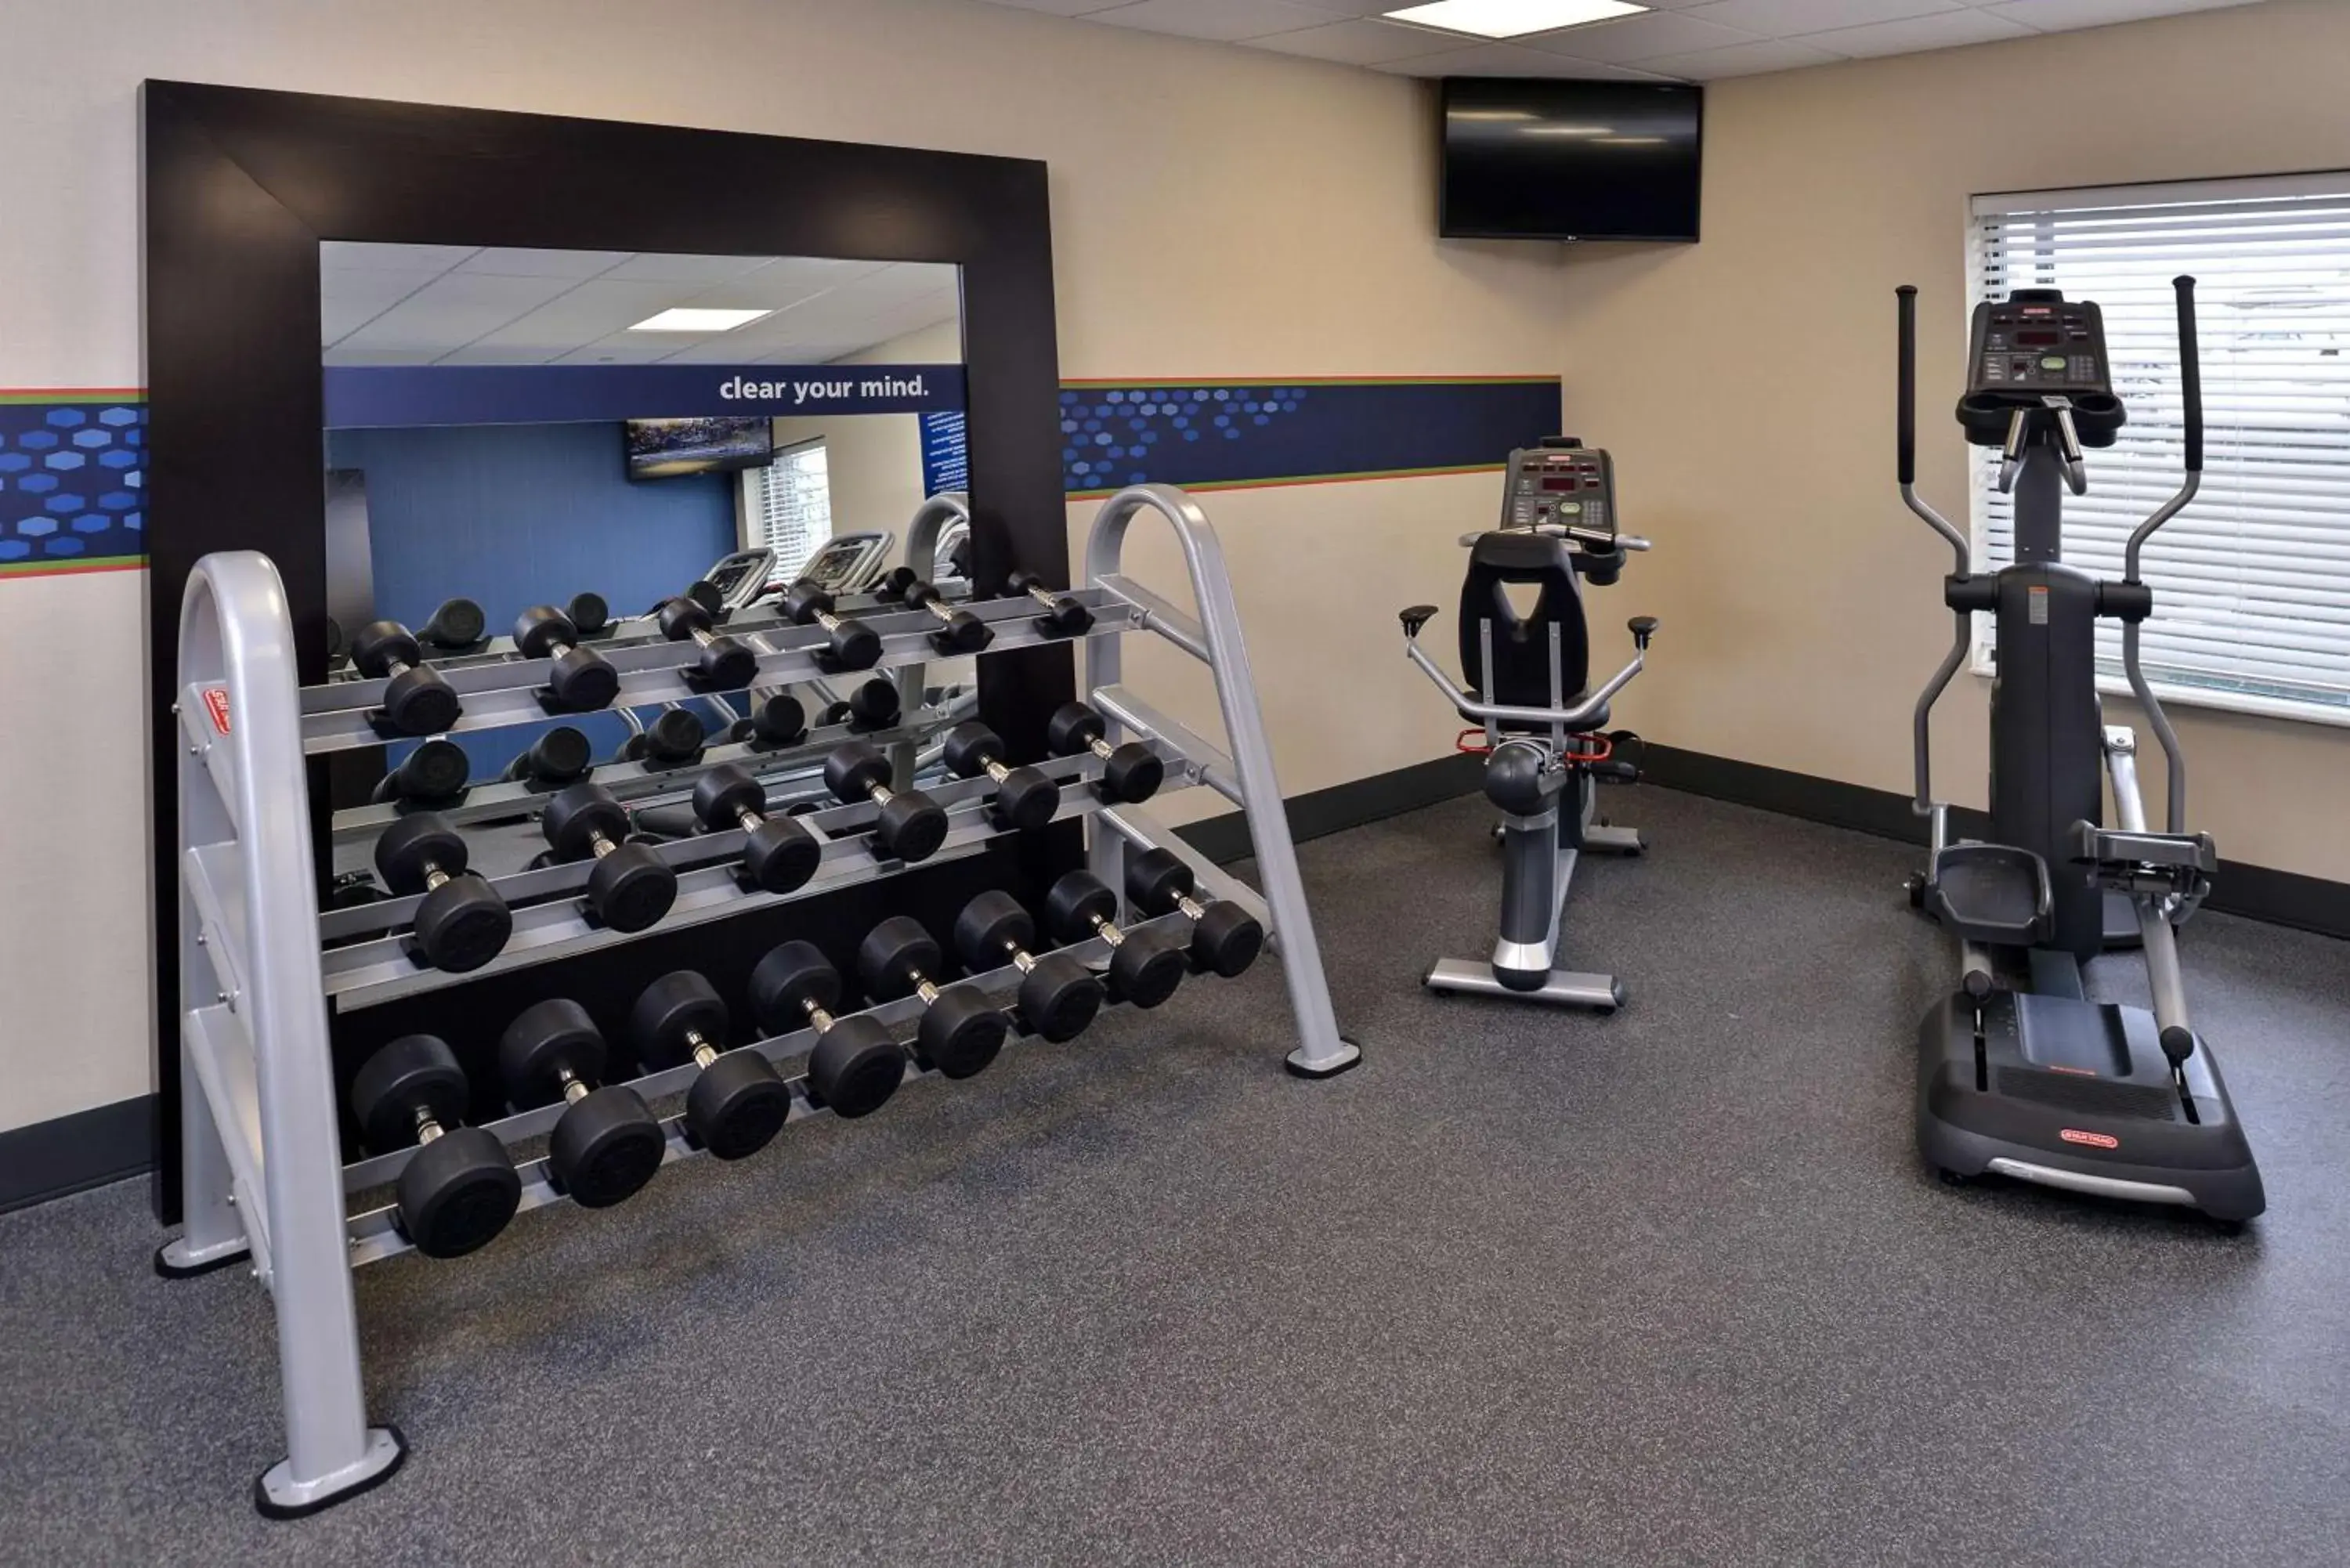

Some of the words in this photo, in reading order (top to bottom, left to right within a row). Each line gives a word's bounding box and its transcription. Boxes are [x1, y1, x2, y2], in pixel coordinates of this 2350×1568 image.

[719, 376, 786, 399] clear
[794, 379, 853, 405] your
[860, 374, 930, 398] mind.
